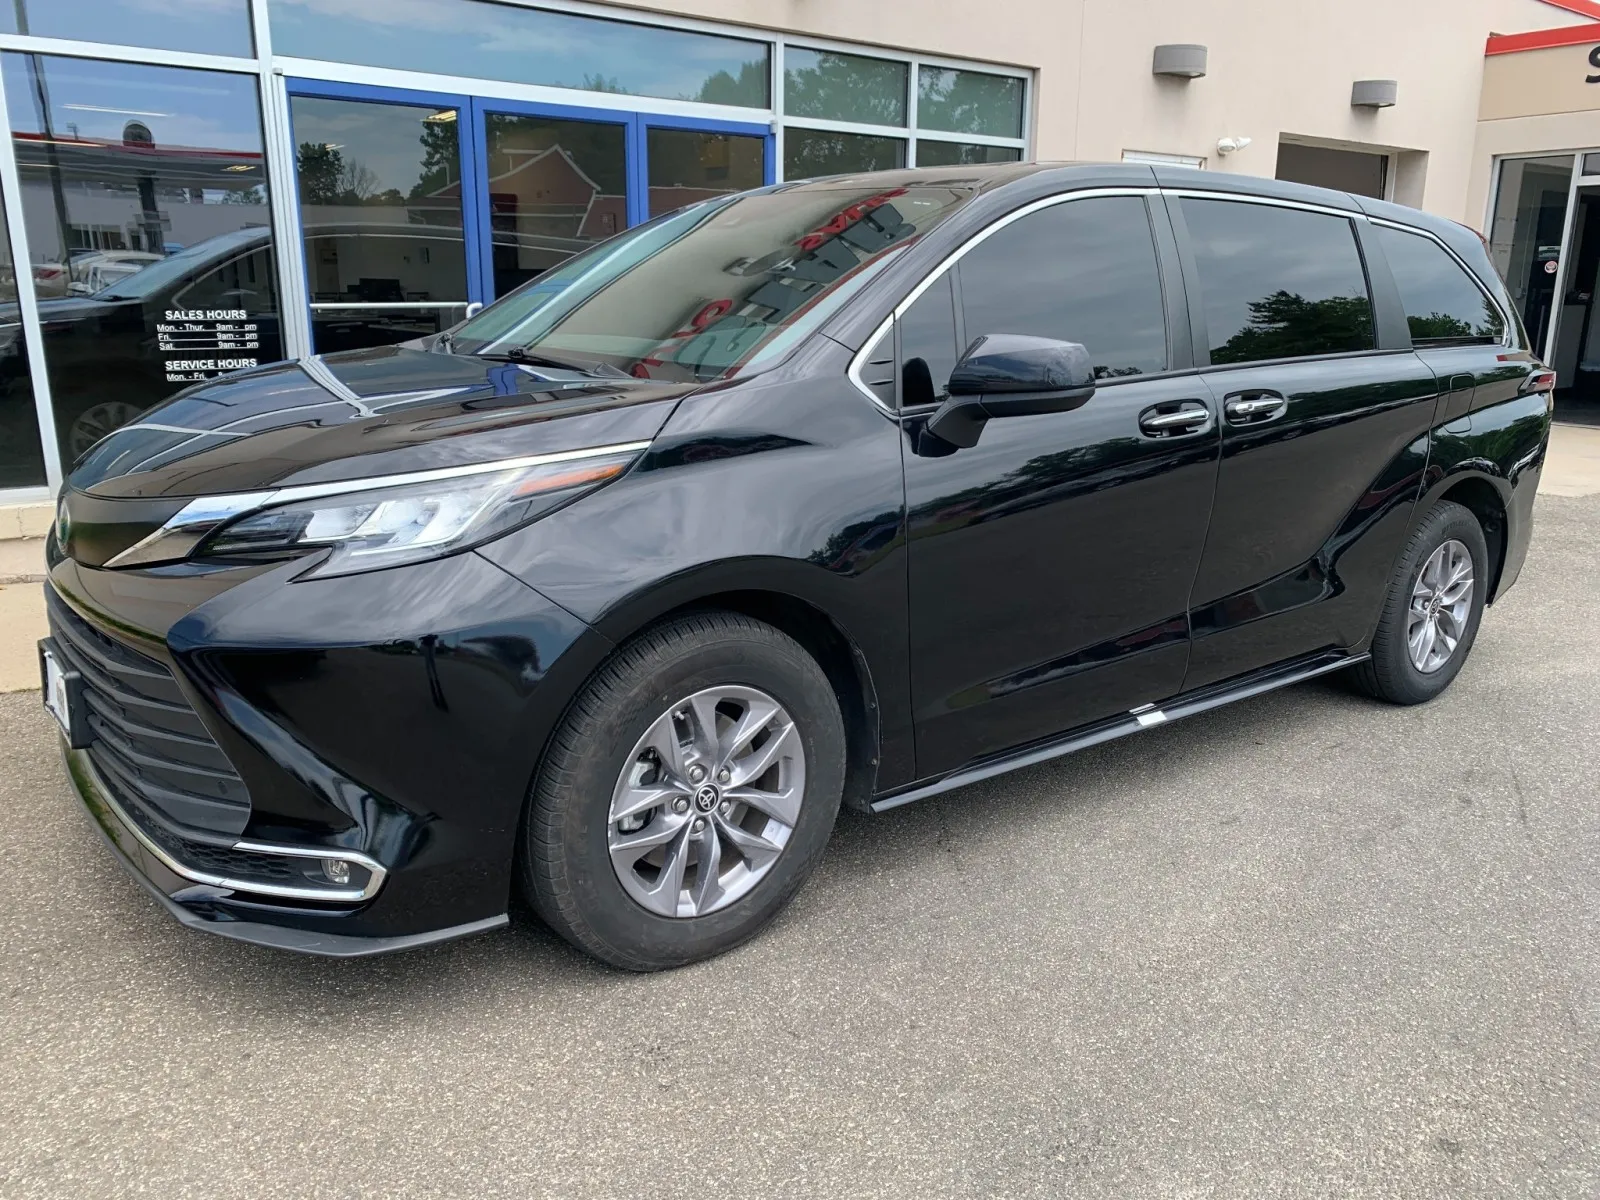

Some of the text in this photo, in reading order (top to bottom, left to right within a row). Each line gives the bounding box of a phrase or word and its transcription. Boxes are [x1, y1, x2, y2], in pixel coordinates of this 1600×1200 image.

[165, 309, 247, 320] SALES HOURS
[157, 324, 178, 332] Mon.
[184, 323, 205, 331] Thur.
[216, 323, 233, 331] 9am
[245, 323, 257, 331] pm
[245, 332, 258, 340] pm
[218, 341, 235, 349] 9am
[246, 341, 259, 349] pm
[165, 358, 257, 370] SERVICE HOURS
[167, 373, 187, 381] Mon.
[194, 372, 207, 380] Fri.
